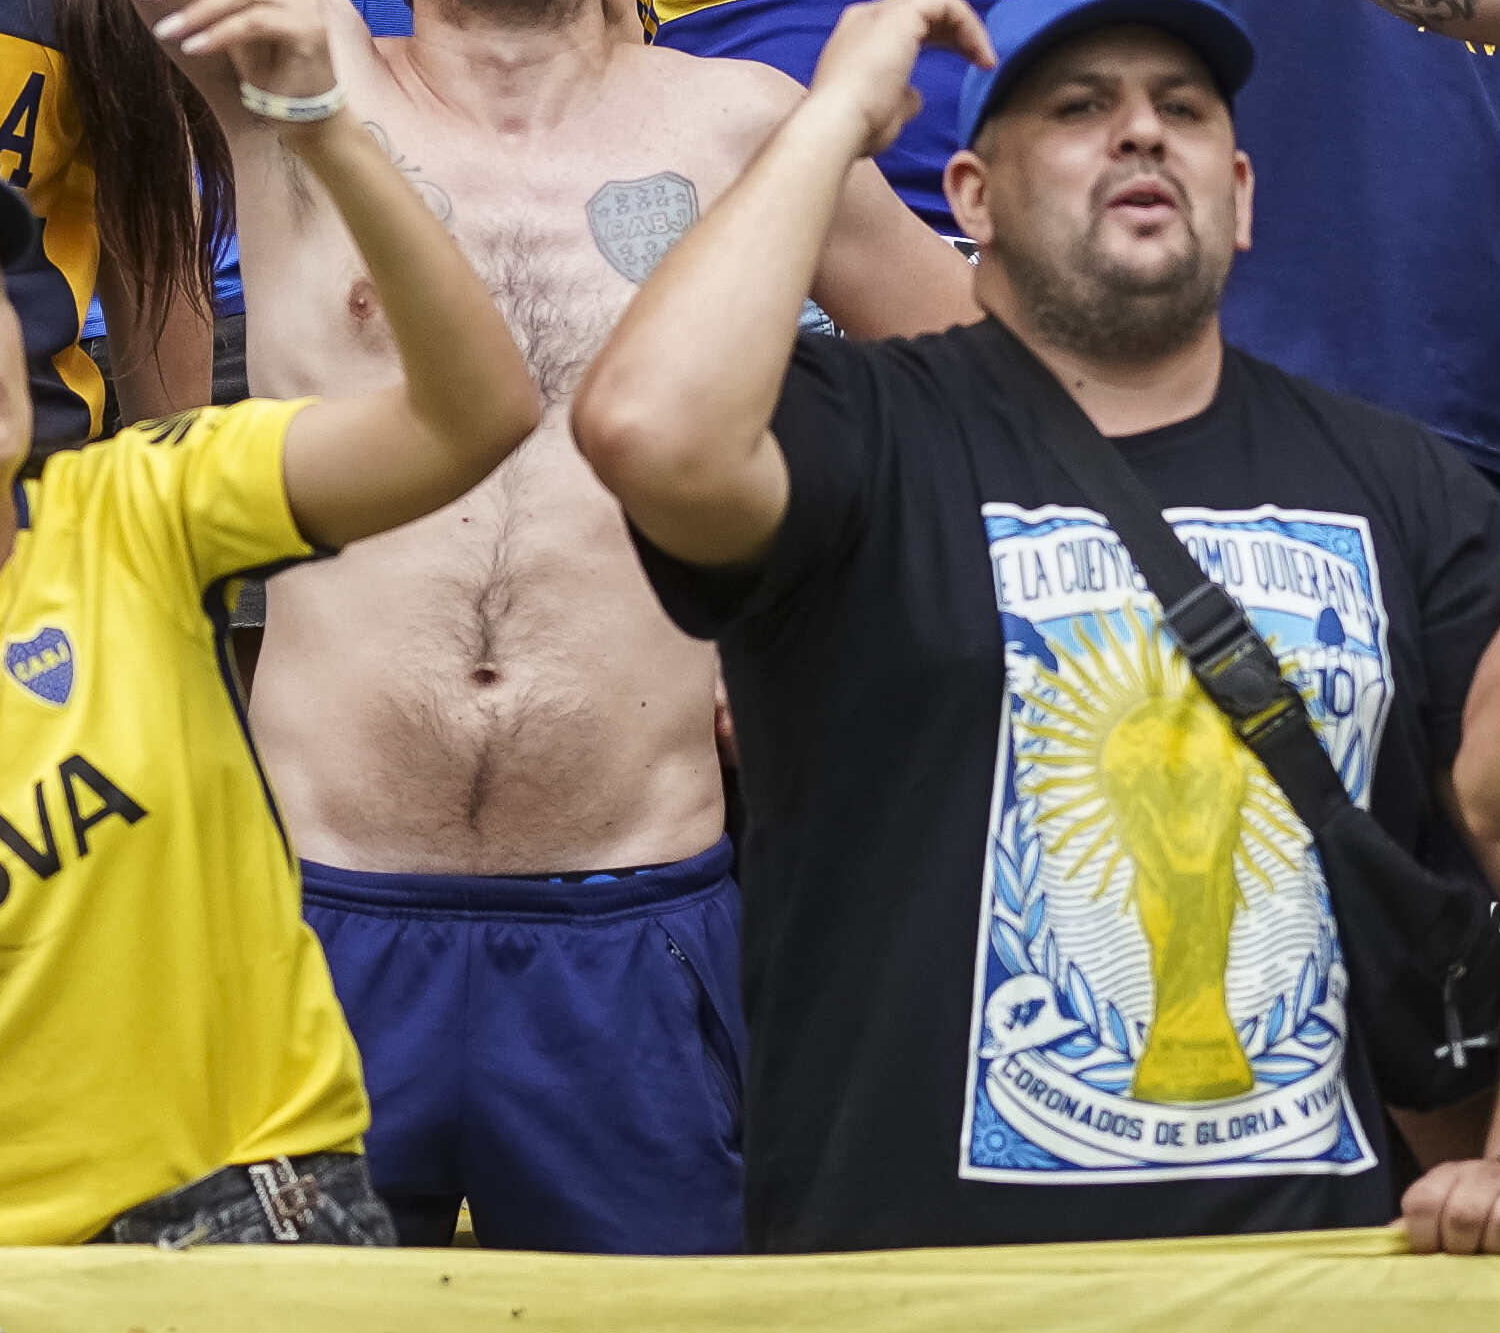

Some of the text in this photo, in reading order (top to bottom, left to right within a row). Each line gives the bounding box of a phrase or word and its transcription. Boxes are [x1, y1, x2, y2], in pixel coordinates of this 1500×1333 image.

[1018, 548, 1052, 601] LA
[1154, 1119, 1187, 1147] DE
[1196, 1102, 1287, 1146] GLORIA
